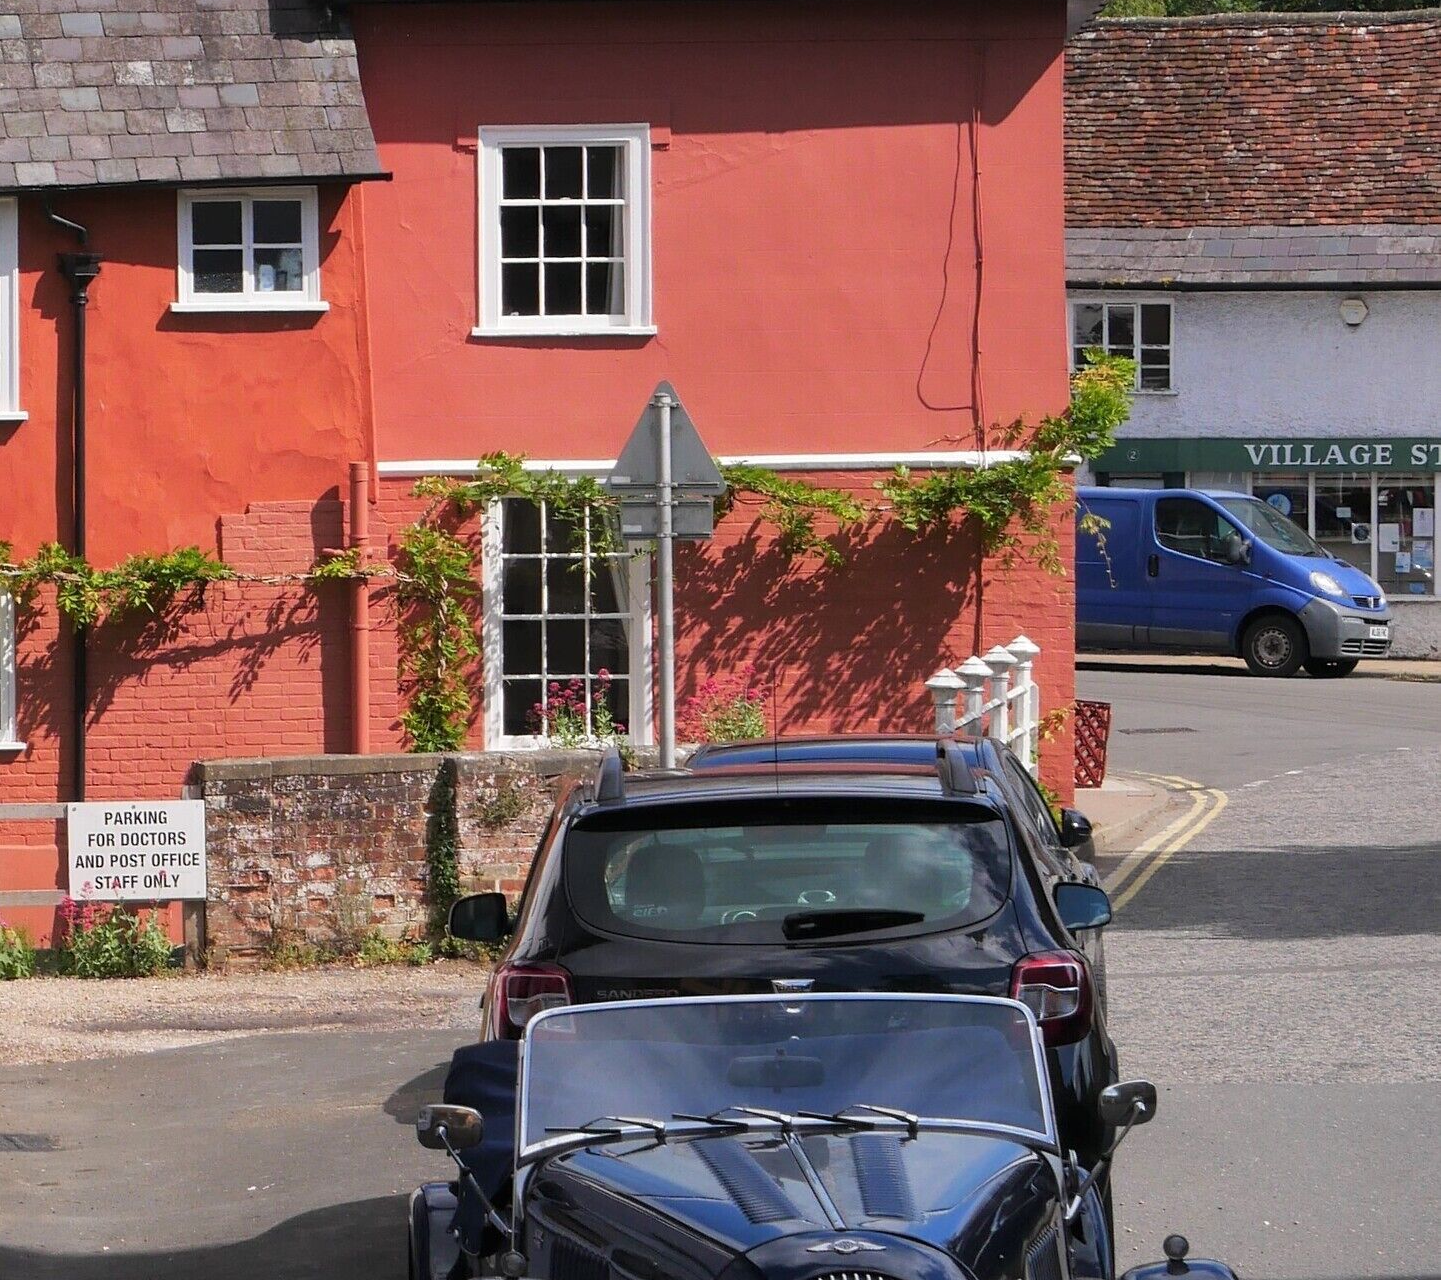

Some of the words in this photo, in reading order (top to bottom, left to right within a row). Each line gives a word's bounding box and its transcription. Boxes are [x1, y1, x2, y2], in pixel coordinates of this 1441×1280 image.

[1244, 444, 1393, 465] VILLAGE
[104, 811, 168, 825] PARKING
[88, 833, 115, 847] FOR
[120, 831, 186, 846] DOCTORS
[75, 854, 104, 868] AND
[110, 853, 147, 867] POST
[151, 852, 200, 866] OFFICE
[95, 875, 138, 890] STAFF
[144, 874, 180, 889] ONLY
